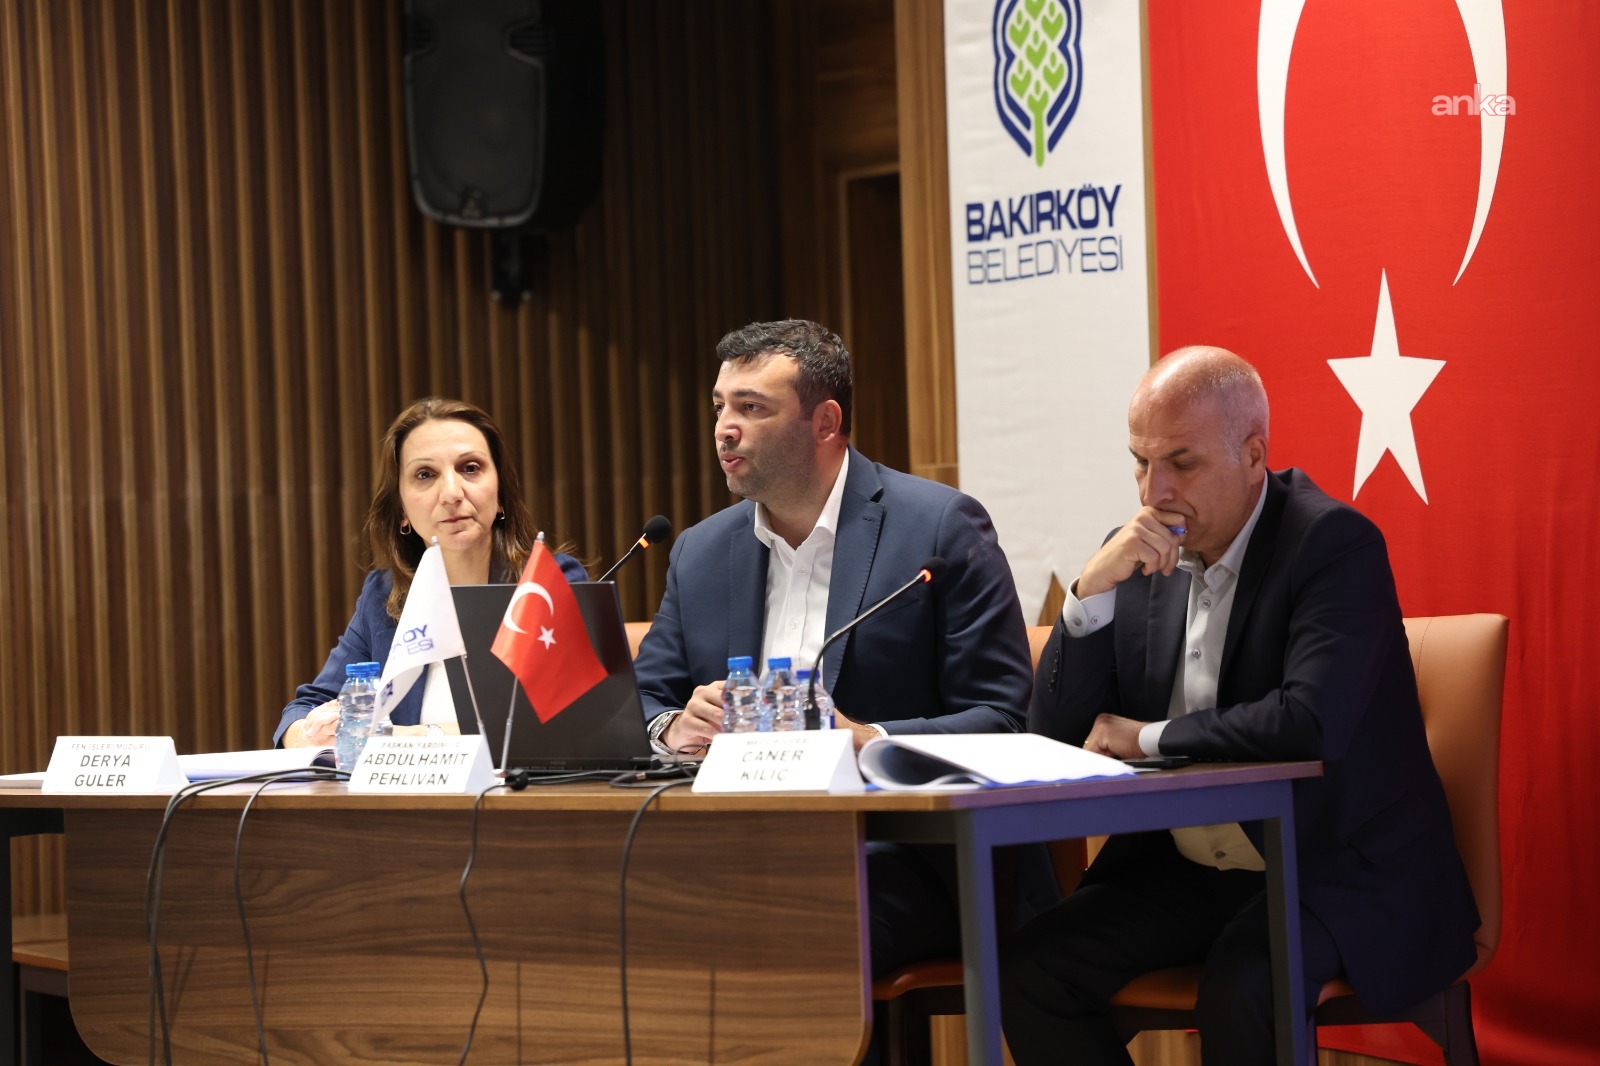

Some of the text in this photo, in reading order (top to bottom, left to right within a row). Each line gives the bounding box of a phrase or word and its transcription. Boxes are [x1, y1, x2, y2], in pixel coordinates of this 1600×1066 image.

[966, 184, 1122, 242] BAKIRKÖY
[80, 754, 131, 767] DERYA
[363, 753, 469, 766] ABDULHAMIT
[742, 750, 804, 763] CANER
[74, 774, 126, 787] GULER
[368, 772, 450, 786] PEHLIVAN
